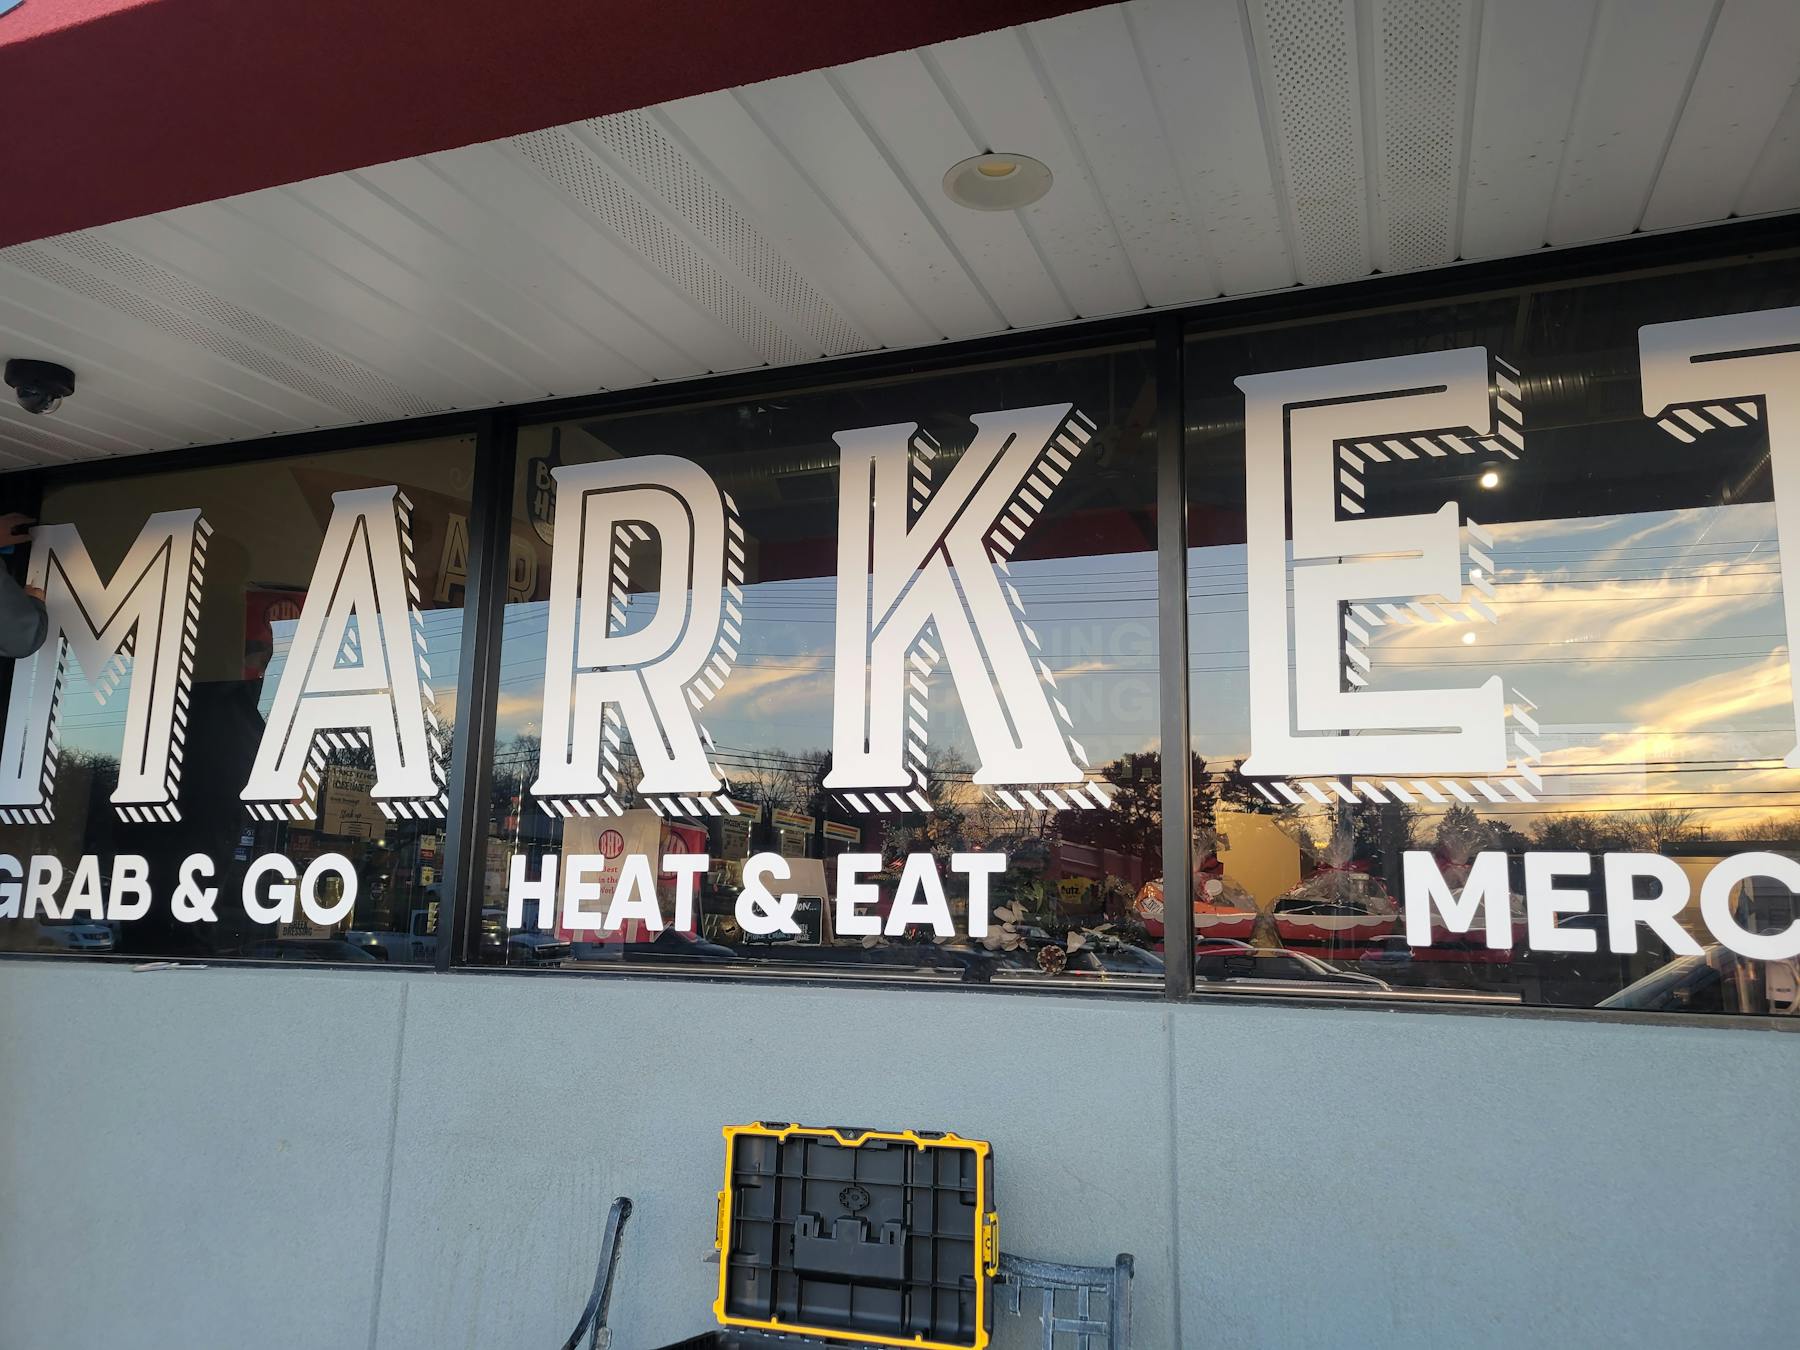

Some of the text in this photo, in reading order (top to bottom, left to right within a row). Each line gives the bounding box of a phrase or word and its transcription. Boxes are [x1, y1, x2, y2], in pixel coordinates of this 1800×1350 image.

[171, 853, 219, 923] &
[242, 853, 358, 926] GO
[506, 852, 1007, 938] HEAT & EAT
[1402, 851, 1800, 961] MERC
